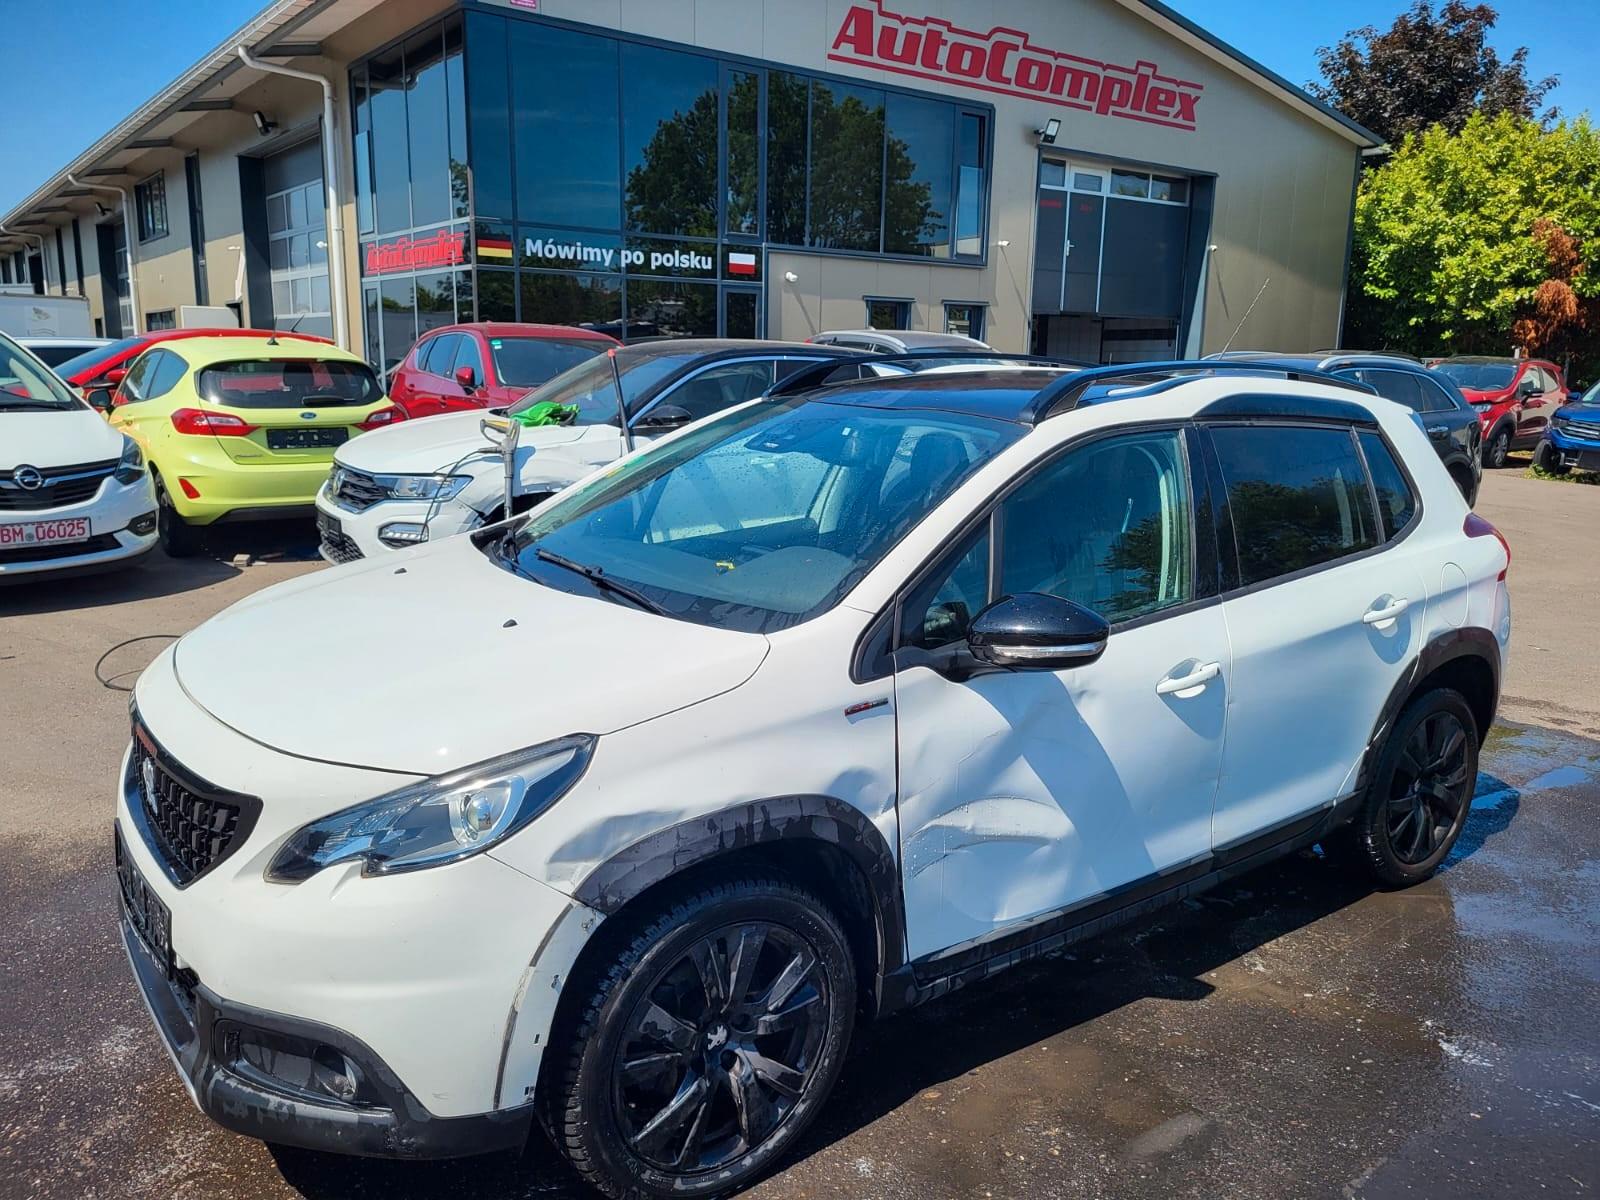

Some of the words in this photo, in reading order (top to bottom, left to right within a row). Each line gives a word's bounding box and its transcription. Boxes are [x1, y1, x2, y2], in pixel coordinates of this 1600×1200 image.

[832, 6, 1200, 122] AutoComplex
[525, 238, 614, 267] Mówimy
[620, 249, 645, 267] po
[650, 250, 713, 270] polsku
[0, 527, 24, 543] BM
[35, 521, 86, 541] 06025
